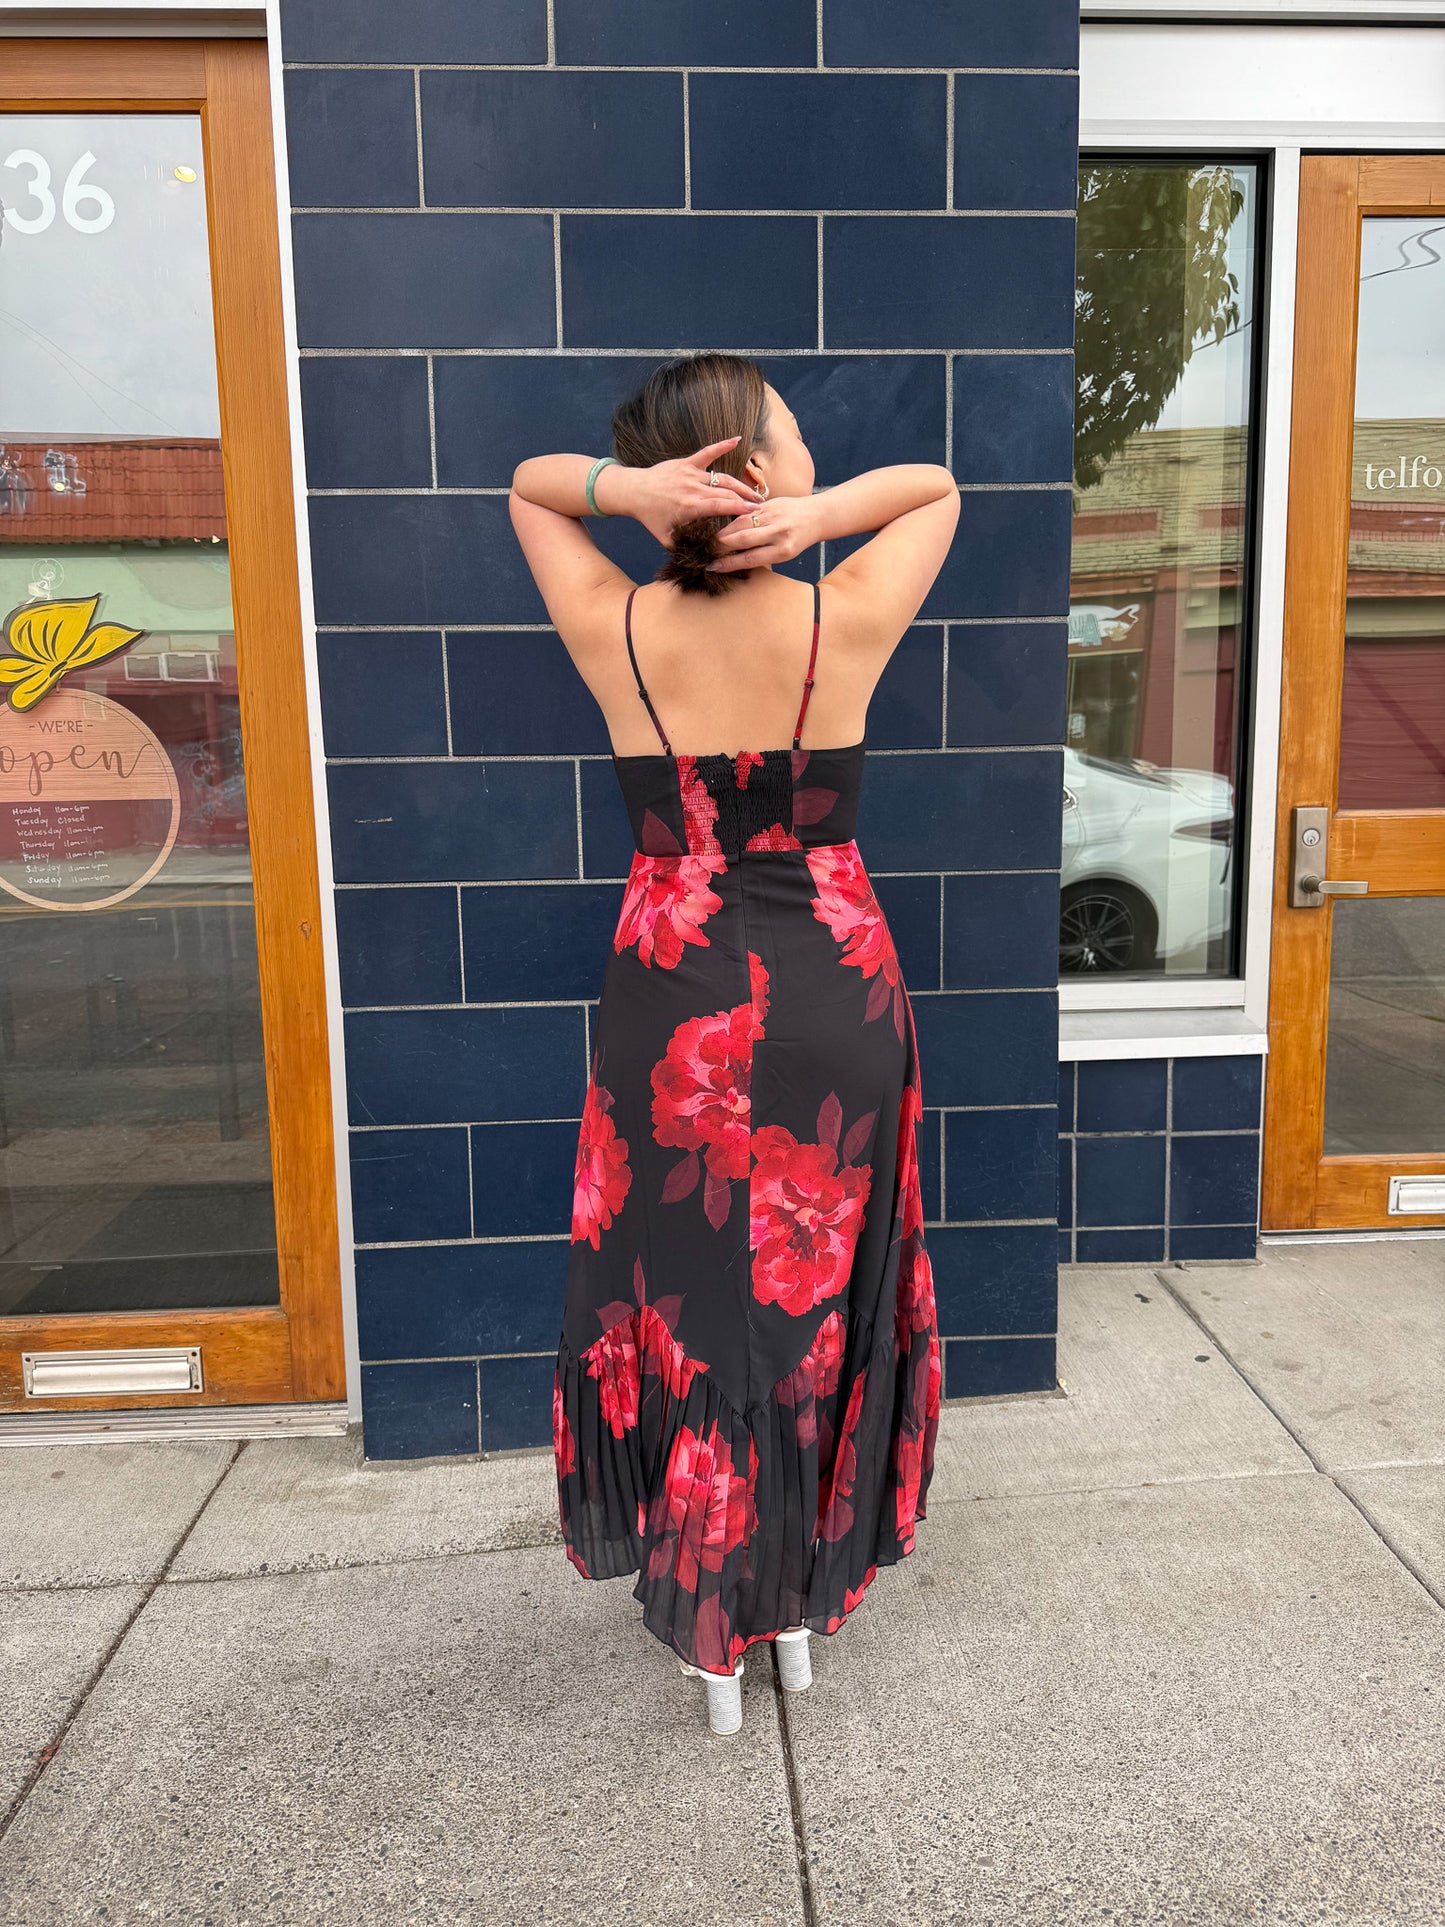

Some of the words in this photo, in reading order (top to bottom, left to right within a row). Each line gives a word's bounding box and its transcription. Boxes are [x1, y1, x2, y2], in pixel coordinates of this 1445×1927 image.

[4, 149, 115, 234] 36
[1364, 455, 1445, 490] telfo
[0, 743, 151, 797] open
[12, 807, 41, 815] Monday
[15, 818, 48, 827] Tuesday
[57, 815, 84, 824] Closed
[17, 828, 61, 839] Wednesday
[20, 841, 55, 849] Thursday
[23, 853, 49, 863] Friday
[28, 877, 62, 888] Sunday
